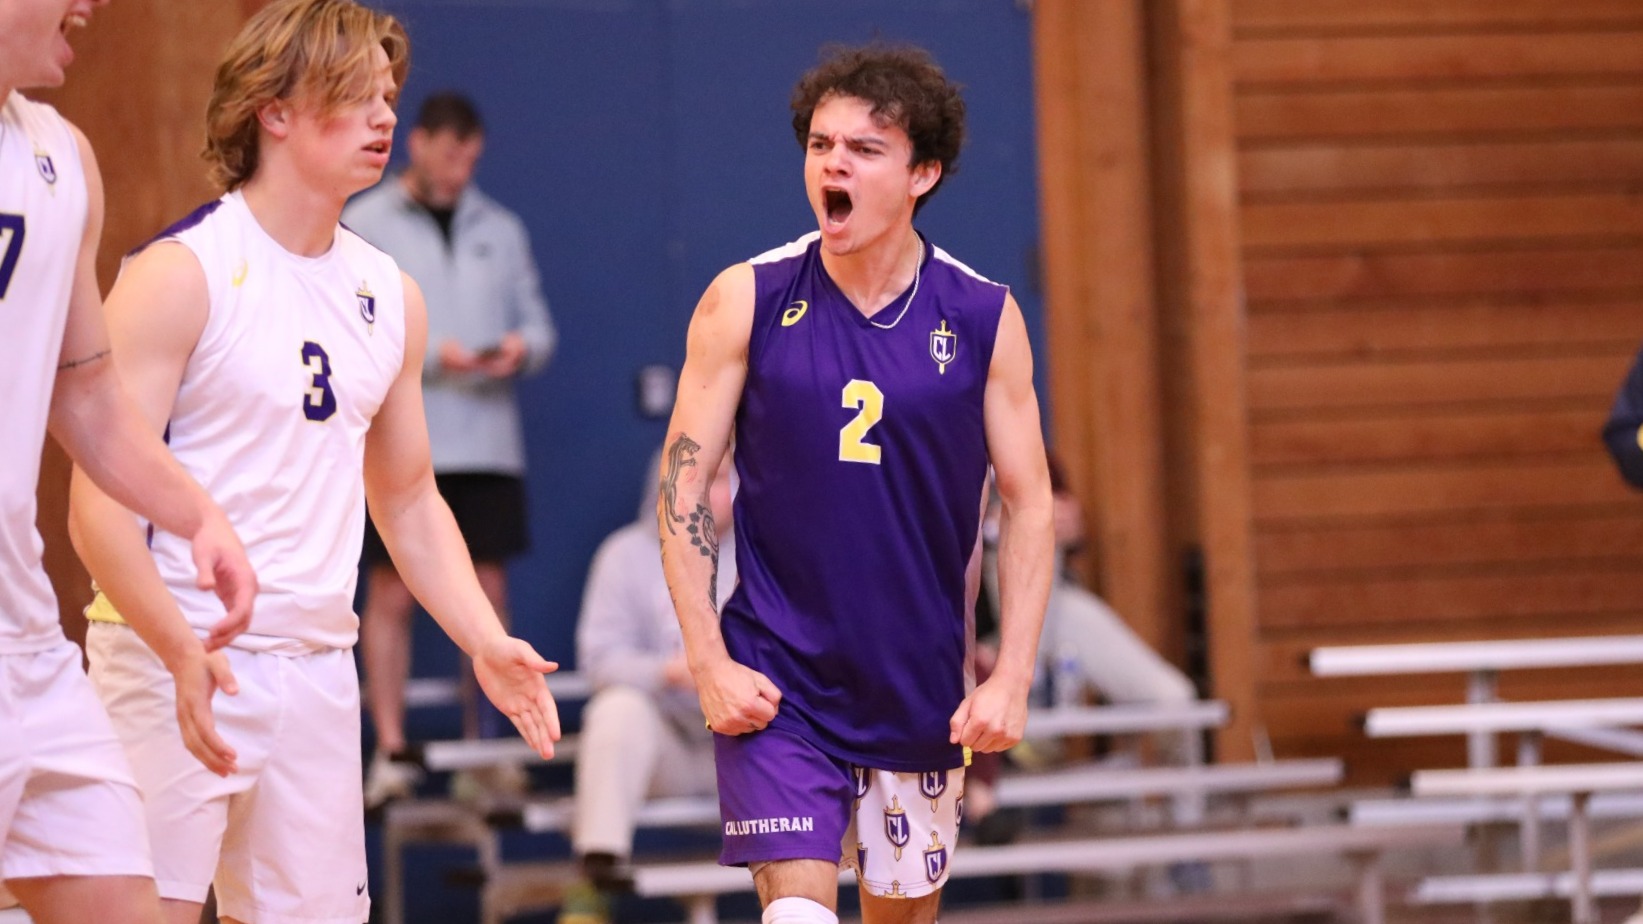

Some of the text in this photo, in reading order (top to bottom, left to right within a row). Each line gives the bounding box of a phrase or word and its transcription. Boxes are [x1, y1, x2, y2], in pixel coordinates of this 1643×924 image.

[0, 213, 25, 300] 7
[933, 335, 952, 361] CL
[300, 340, 338, 423] 3
[838, 378, 885, 465] 2
[725, 816, 814, 836] CAL LUTHERAN
[886, 816, 908, 844] CL
[926, 852, 943, 880] CL
